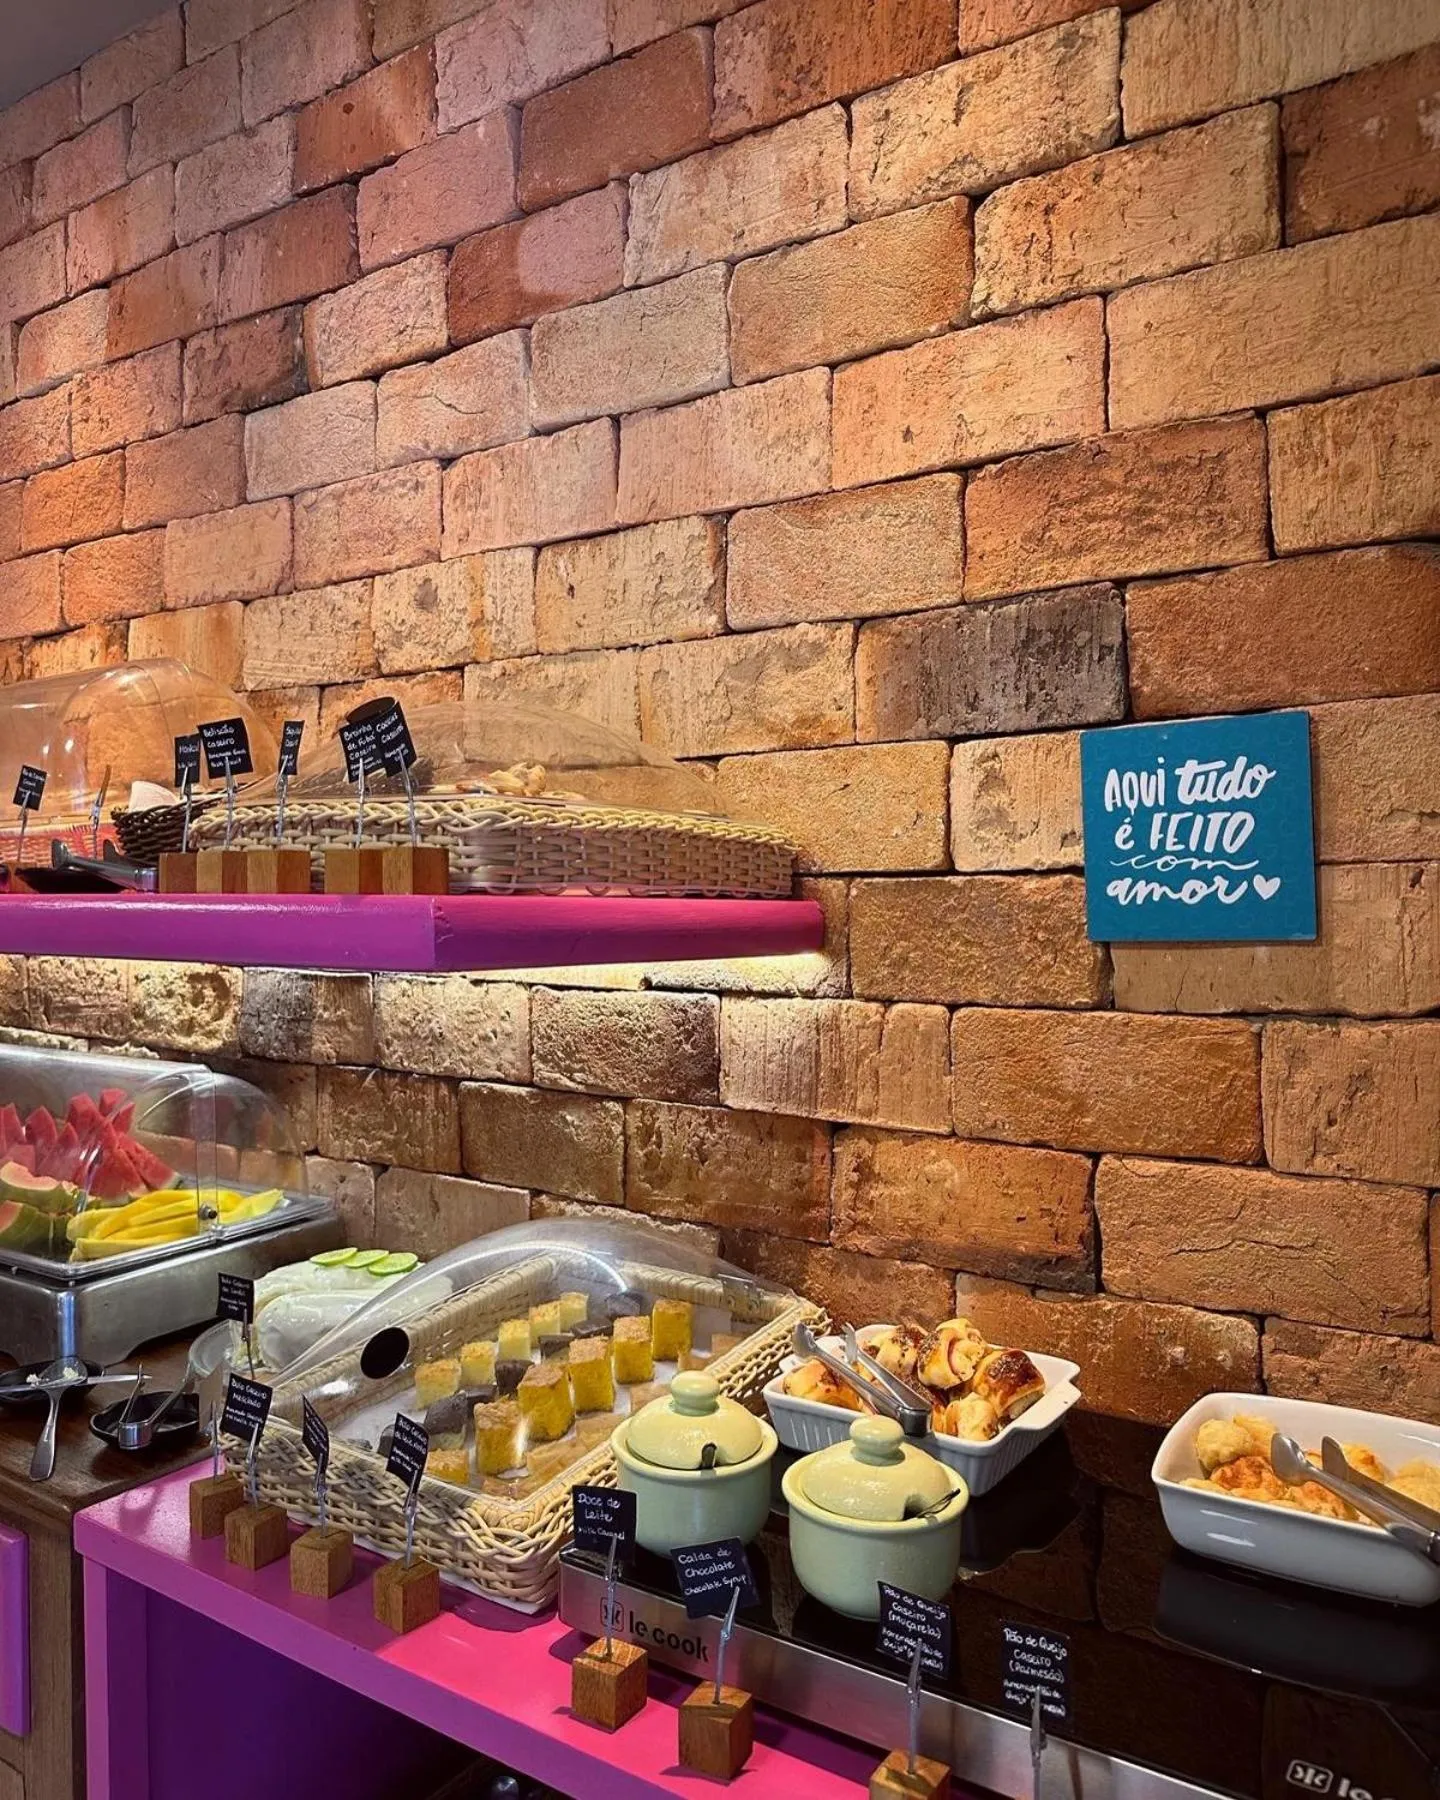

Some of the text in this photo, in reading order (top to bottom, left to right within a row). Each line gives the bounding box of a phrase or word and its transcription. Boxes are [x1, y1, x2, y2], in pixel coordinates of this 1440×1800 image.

[1174, 756, 1277, 805] tudo
[1114, 811, 1255, 854] é FEITO
[1109, 854, 1260, 872] com
[1106, 875, 1249, 906] amor
[577, 1492, 621, 1509] Doce de
[678, 1551, 713, 1565] Calda
[1003, 1628, 1024, 1644] Pão
